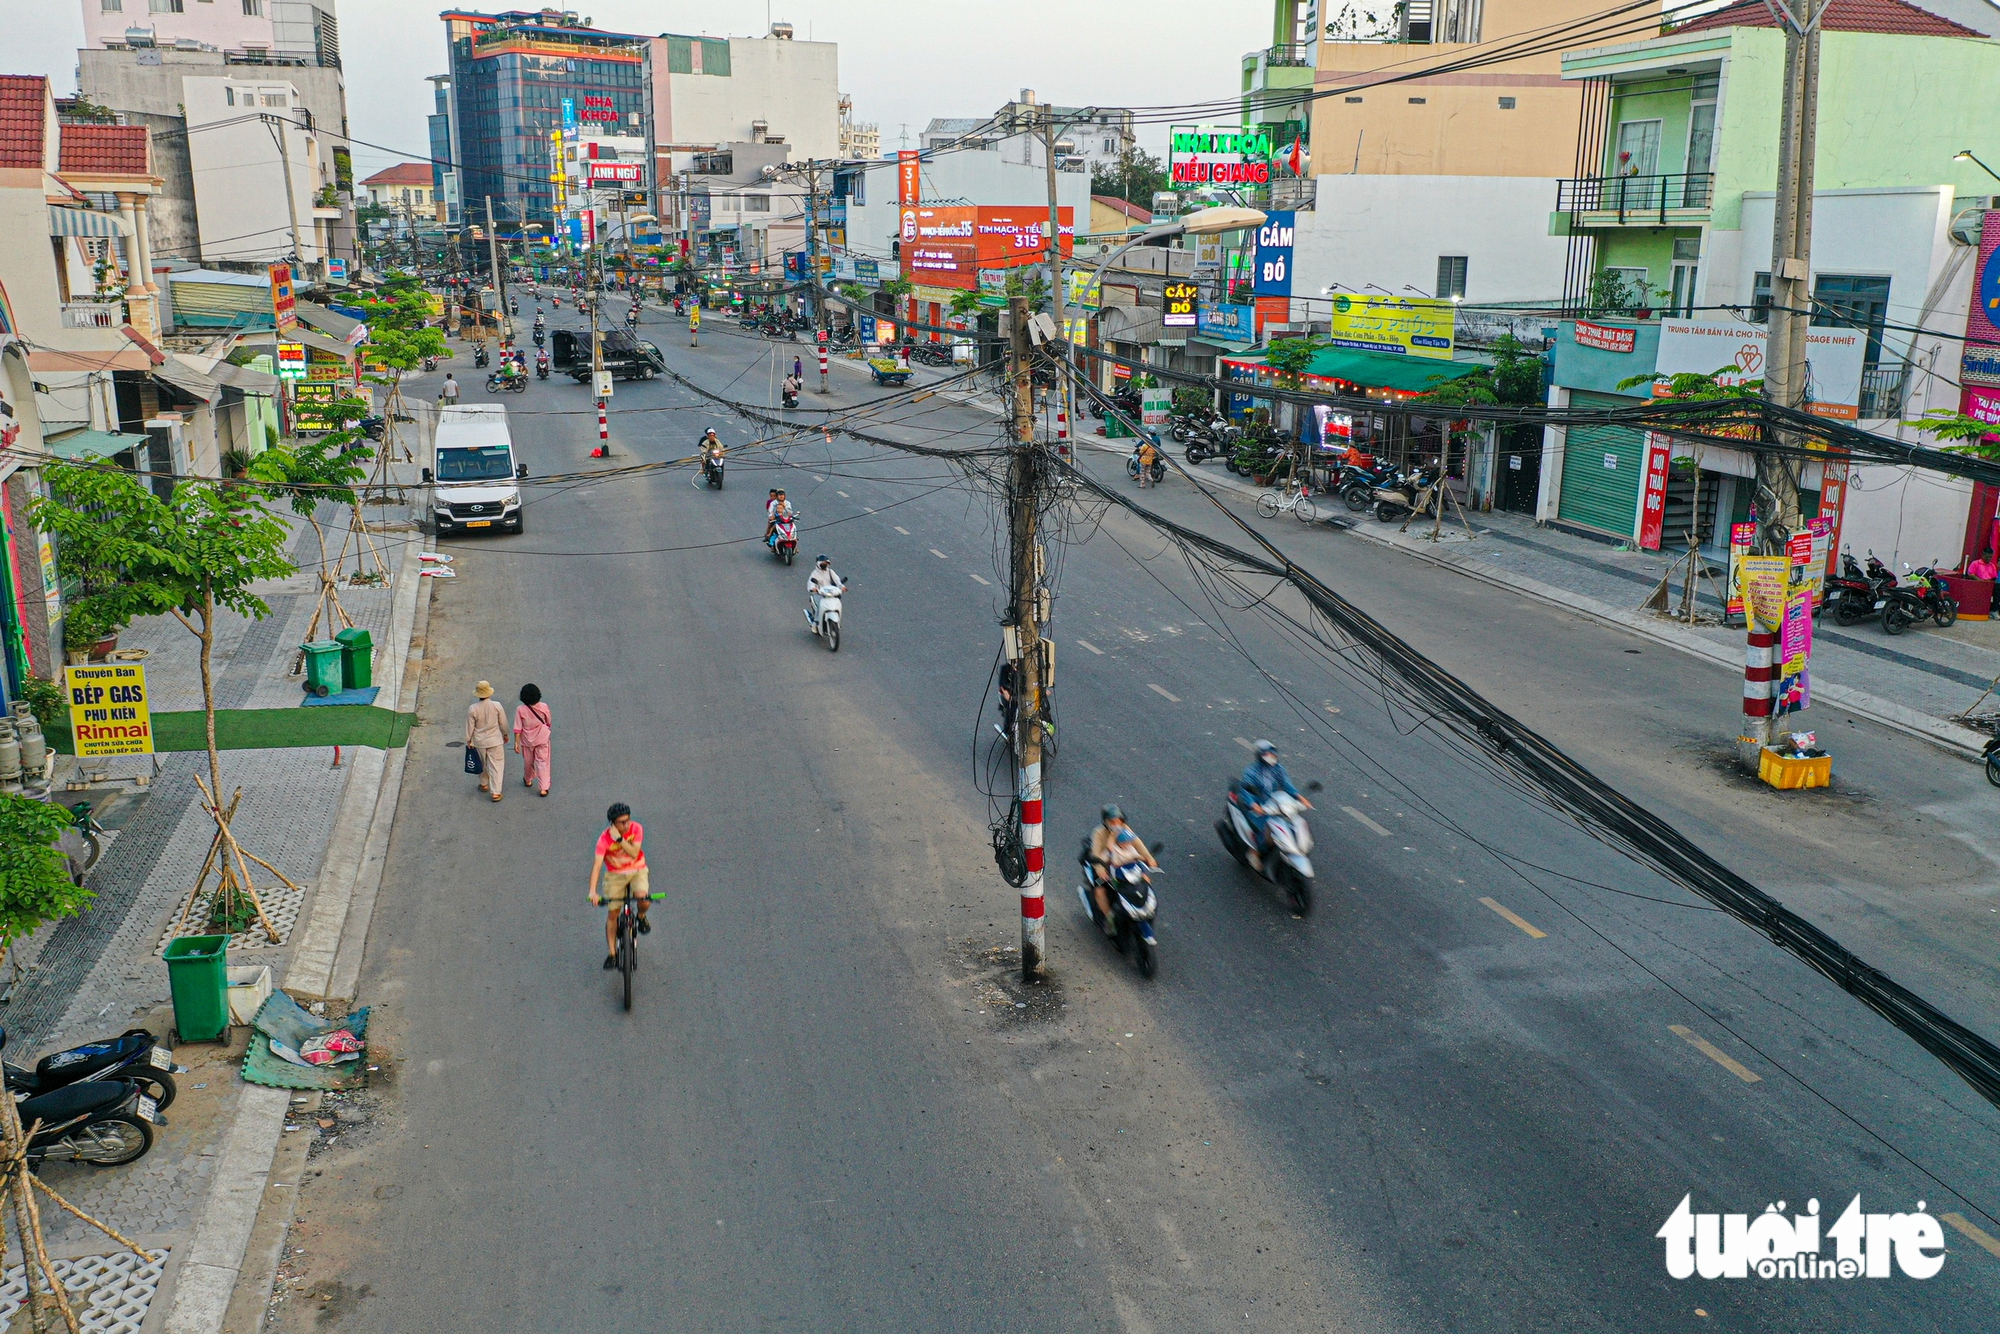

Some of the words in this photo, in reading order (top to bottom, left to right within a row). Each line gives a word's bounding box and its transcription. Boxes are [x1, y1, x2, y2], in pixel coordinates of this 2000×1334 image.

[584, 96, 613, 108] NHA
[581, 110, 618, 122] KHOA
[1174, 133, 1211, 153] NHA
[1216, 133, 1269, 154] KHOA
[593, 167, 614, 179] ANH
[617, 164, 637, 179] NGỮ
[1173, 156, 1208, 183] KIỀU
[1213, 163, 1269, 183] GIANG
[978, 225, 993, 234] TIM
[994, 225, 1018, 236] MẠCH
[1058, 224, 1074, 234] ỜNG
[1260, 221, 1293, 247] CẦM
[1014, 234, 1039, 248] 315
[1263, 255, 1286, 282] ĐỒ
[1165, 283, 1197, 298] CẦM
[1170, 299, 1191, 313] ĐỒ
[1668, 325, 1689, 335] TRUNG
[1691, 325, 1706, 335] TÂM
[1707, 326, 1722, 337] BÁN
[1723, 327, 1733, 337] VÀ
[1737, 330, 1753, 338] CHO
[1754, 331, 1768, 340] THU
[1806, 334, 1831, 344] SSAGE
[1832, 335, 1856, 348] NHIỆT
[1963, 354, 2000, 376] Simila
[298, 385, 314, 393] MUA
[316, 384, 331, 393] BÁN
[1144, 400, 1155, 411] NHA
[1647, 492, 1661, 513] ĐỘC
[74, 669, 113, 679] Chuyên
[116, 668, 135, 677] Bán
[72, 681, 104, 705] BẾP
[109, 685, 143, 703] GAS
[84, 709, 107, 723] PHỤ
[110, 705, 136, 722] KIỆN
[76, 721, 148, 740] Rinnai
[84, 740, 110, 748] CHUYÊN
[111, 739, 124, 747] SỬA
[86, 748, 99, 756] CÁC
